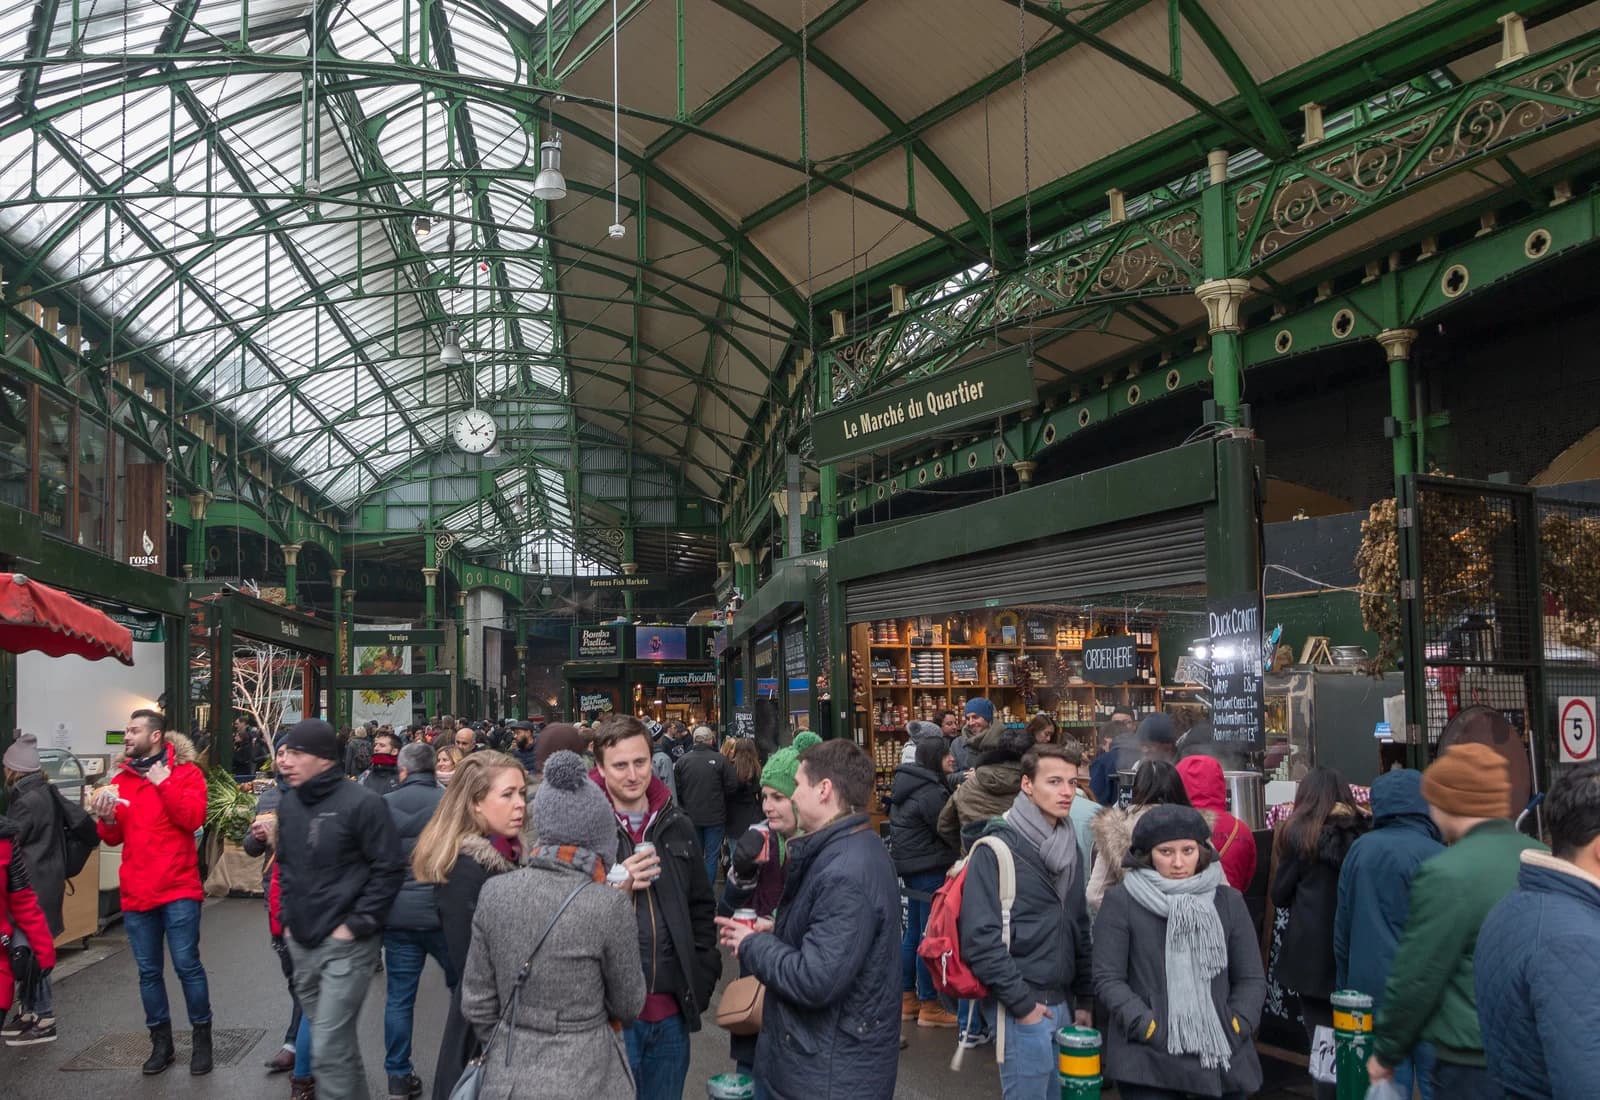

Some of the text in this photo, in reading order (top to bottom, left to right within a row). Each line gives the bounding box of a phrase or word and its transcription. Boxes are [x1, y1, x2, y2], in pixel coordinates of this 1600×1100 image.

[843, 380, 985, 440] Le Marché du Quartier
[129, 555, 159, 565] roast
[613, 578, 625, 586] Fish
[626, 577, 649, 585] Markets
[582, 630, 610, 639] Bomba
[1085, 646, 1133, 670] ORDER HERE
[658, 672, 717, 684] Furness Food Hu
[1573, 718, 1583, 740] 5
